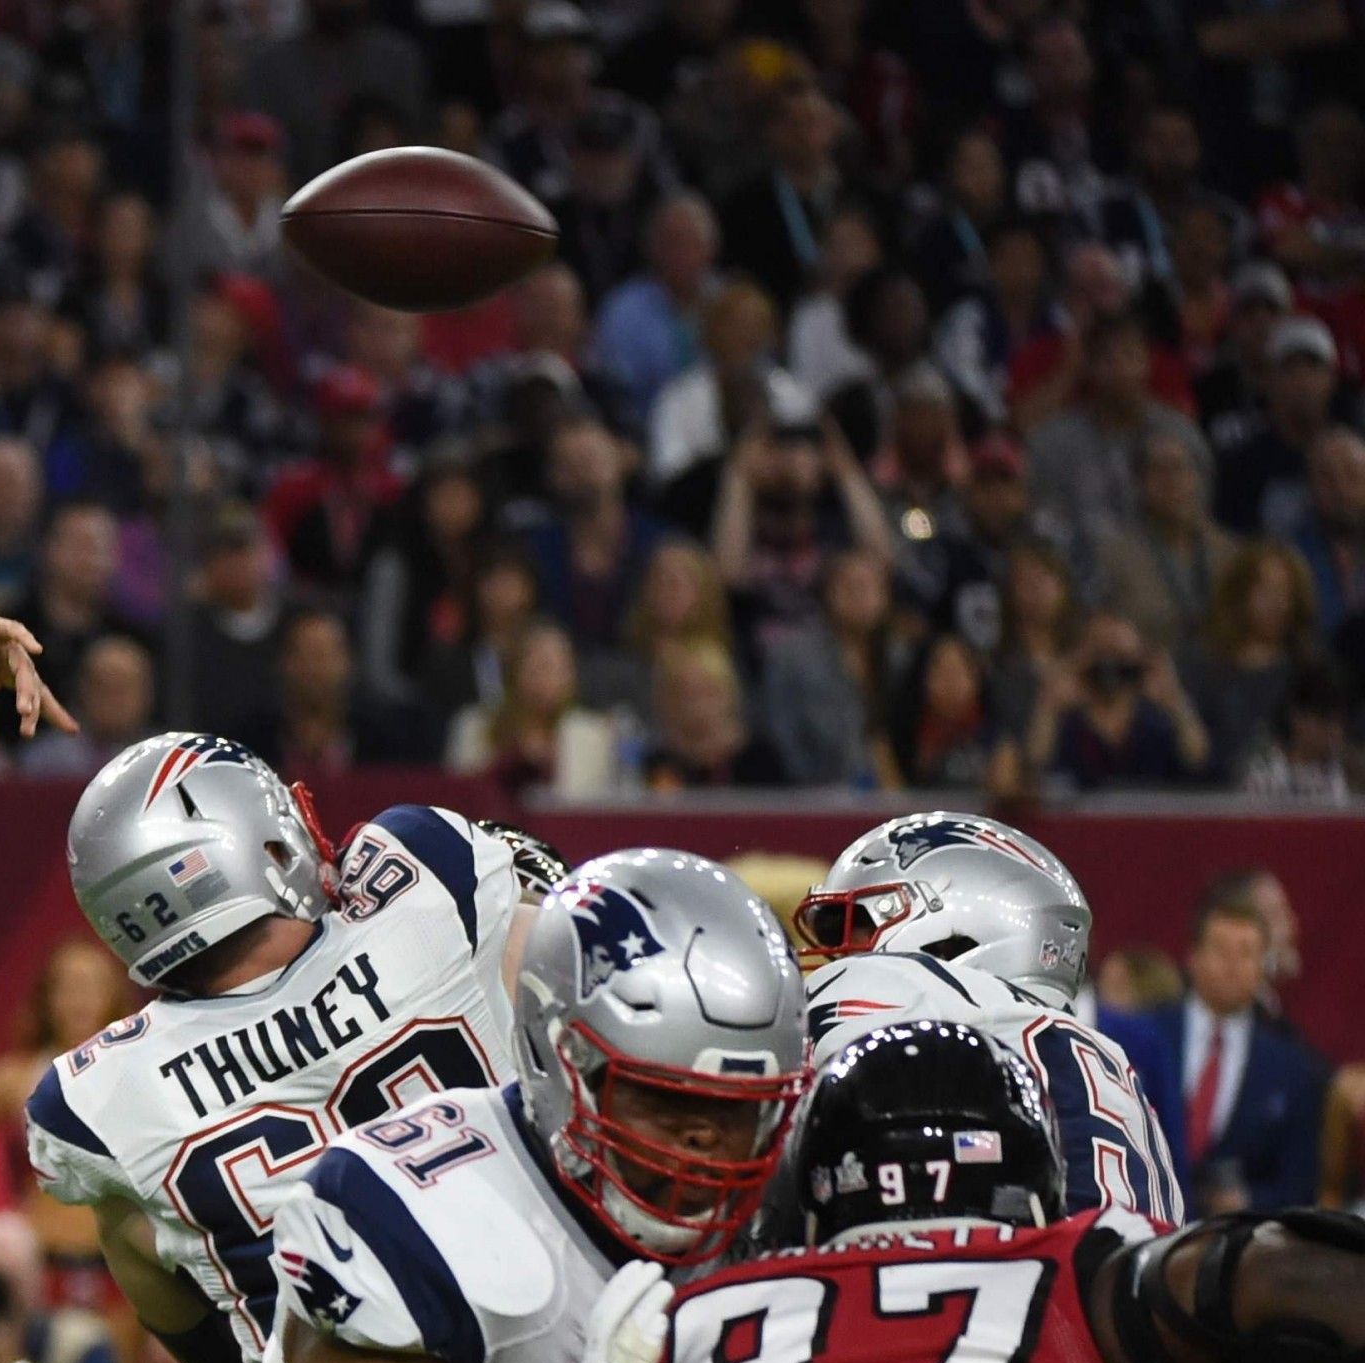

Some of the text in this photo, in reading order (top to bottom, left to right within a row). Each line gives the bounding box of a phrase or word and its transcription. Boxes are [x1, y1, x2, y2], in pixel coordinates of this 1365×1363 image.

[116, 892, 179, 943] 62
[161, 953, 390, 1118] THUNEY
[356, 1100, 496, 1189] 61
[878, 1162, 951, 1206] 97
